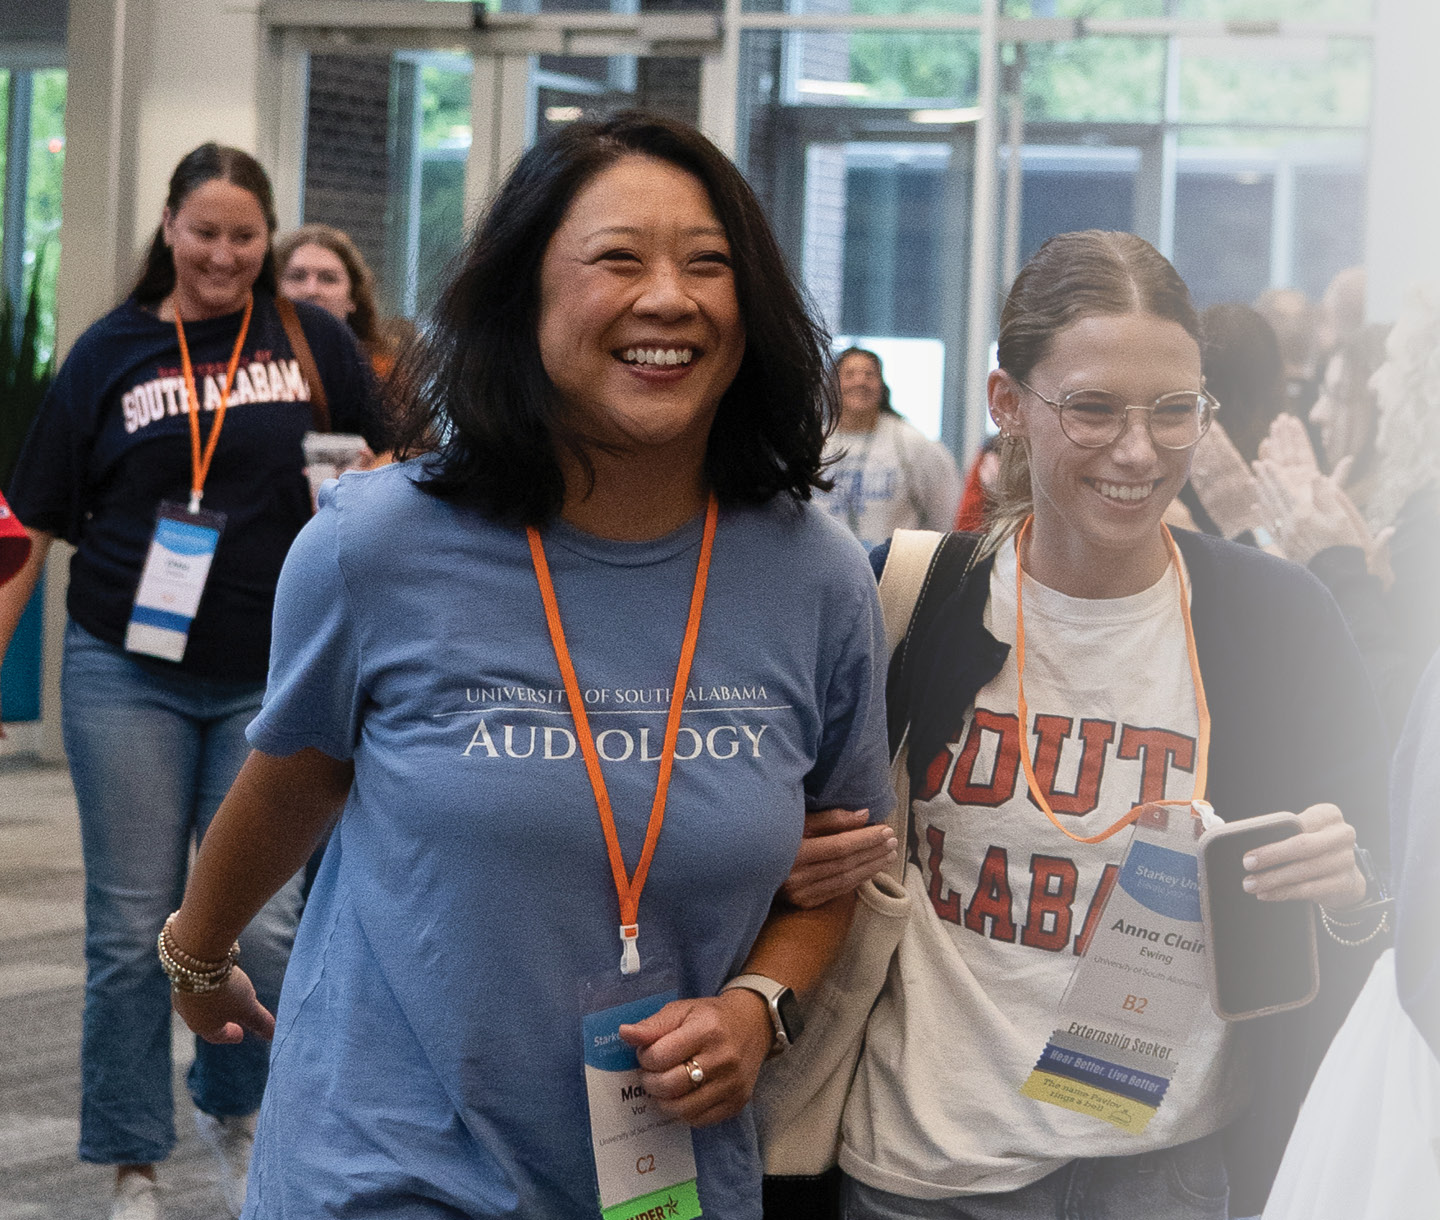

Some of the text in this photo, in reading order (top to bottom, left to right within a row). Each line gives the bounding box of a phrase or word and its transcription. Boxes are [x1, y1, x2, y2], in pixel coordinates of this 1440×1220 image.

[466, 686, 567, 704] UNIVERSIT
[585, 689, 610, 703] OF
[685, 686, 768, 701] ALABAMA
[461, 718, 768, 761] AUDOLOGY
[917, 707, 1199, 826] OUT
[1135, 864, 1199, 890] Starkey Un
[926, 824, 1120, 956] LAB
[1110, 918, 1161, 942] Anna
[1140, 946, 1173, 965] Ewing
[1122, 994, 1148, 1014] B2
[1067, 1021, 1173, 1060] Externship Seeker
[1050, 1049, 1074, 1065] Hear
[1107, 1068, 1128, 1083] Live
[1128, 1075, 1160, 1093] Better
[1043, 1078, 1061, 1089] The
[1063, 1084, 1089, 1097] name
[636, 1154, 656, 1174] C2
